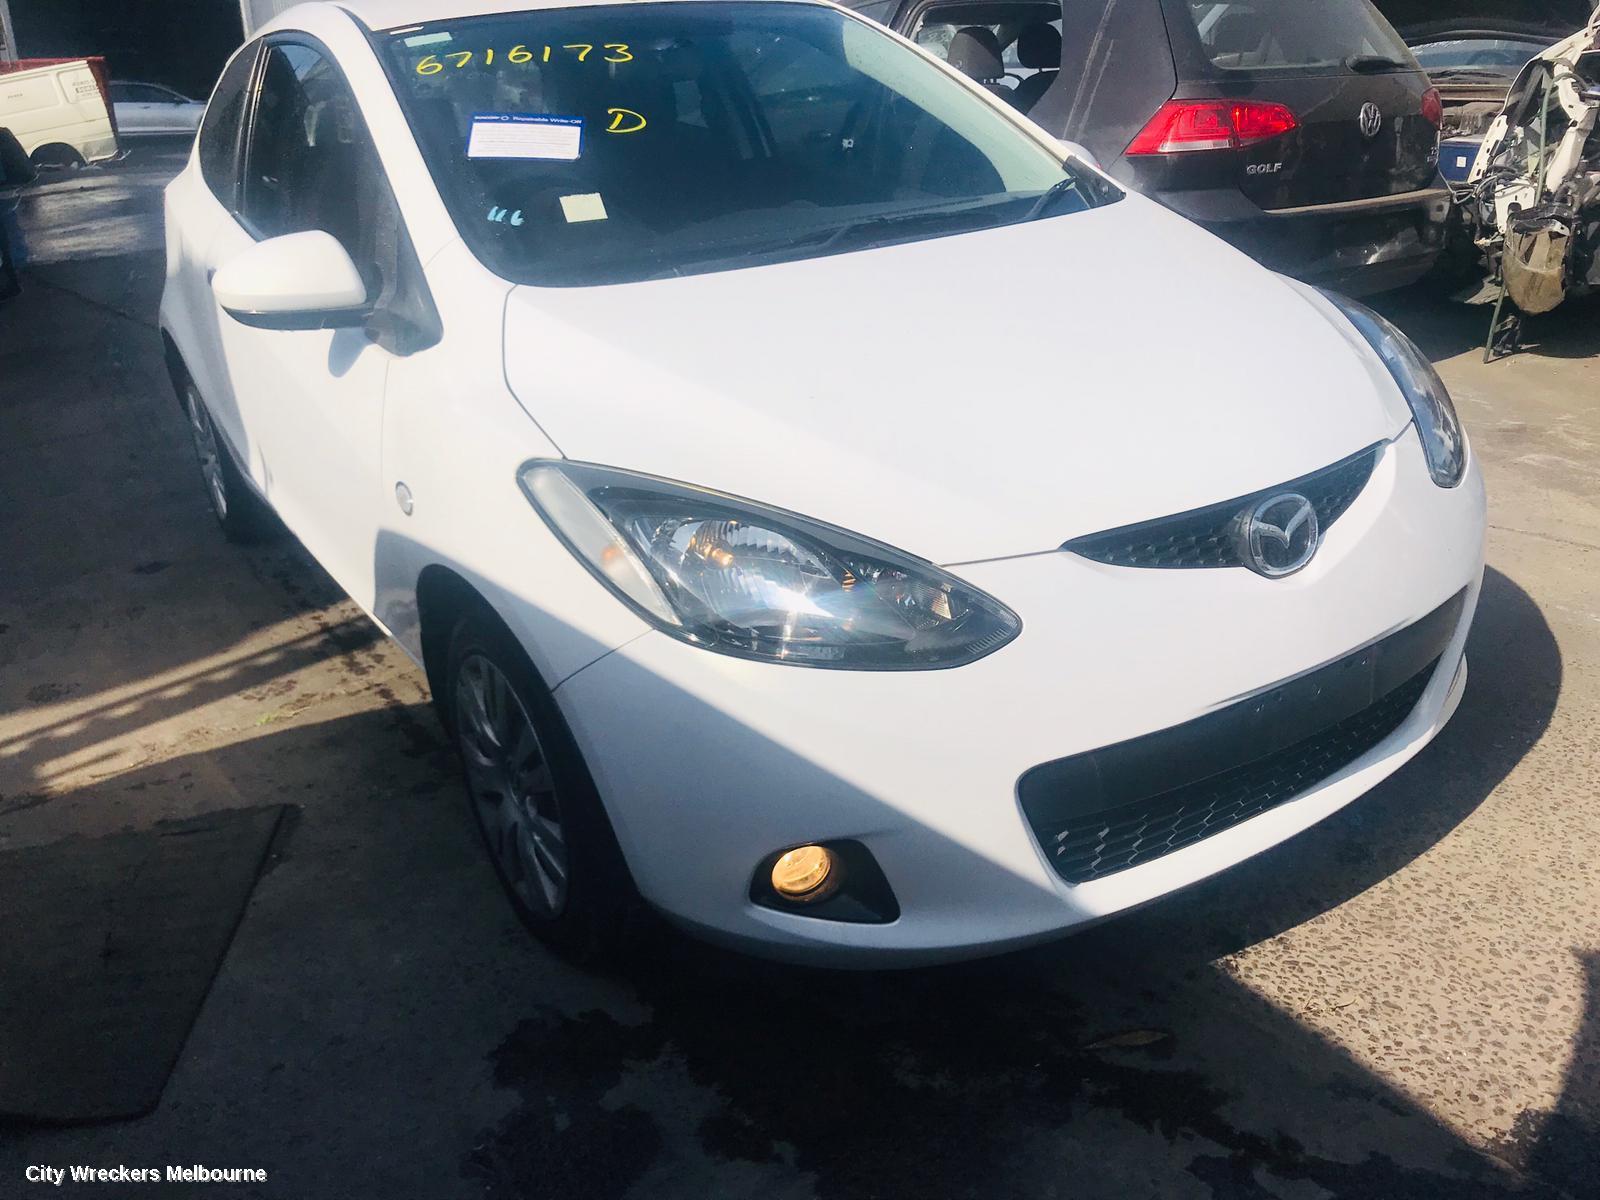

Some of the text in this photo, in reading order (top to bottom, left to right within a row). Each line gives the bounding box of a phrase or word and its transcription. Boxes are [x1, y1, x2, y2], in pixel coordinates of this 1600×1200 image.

[416, 43, 634, 75] 6716173
[605, 107, 647, 133] D
[1246, 162, 1282, 175] GOLF
